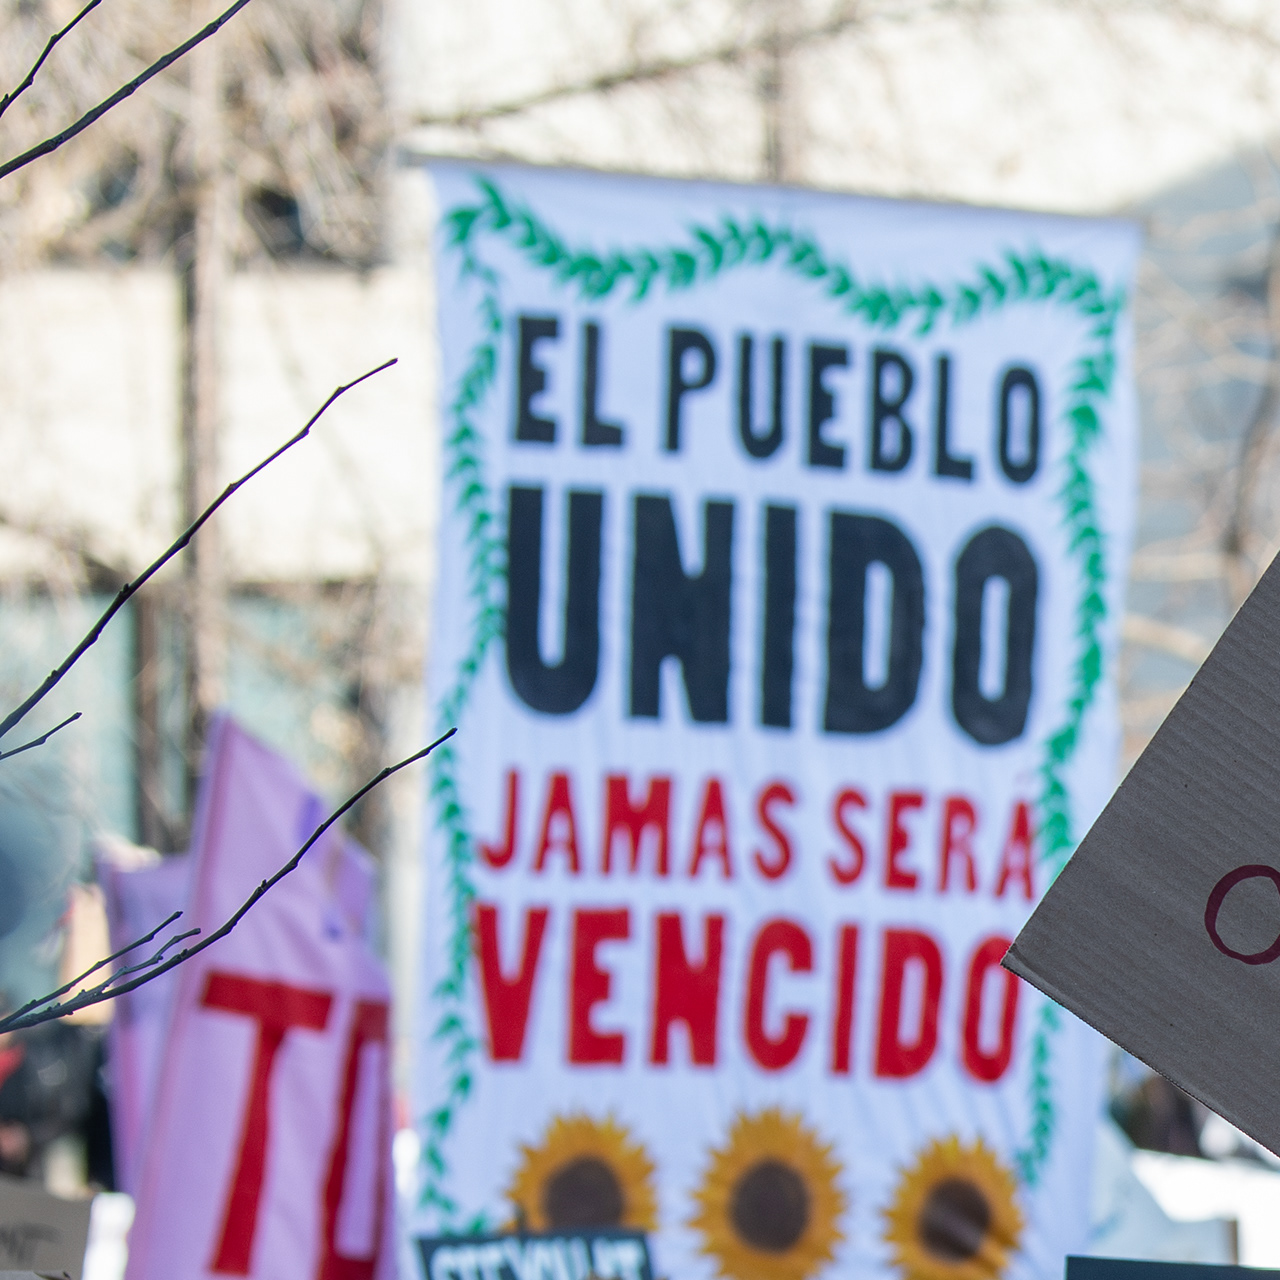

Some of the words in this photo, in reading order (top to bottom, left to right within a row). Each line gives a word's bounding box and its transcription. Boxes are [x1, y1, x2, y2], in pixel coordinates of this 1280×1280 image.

[512, 316, 625, 447] EL
[664, 326, 1041, 485] PUEBLO
[505, 485, 1040, 747] UNIDO
[480, 770, 796, 881] JAMAS
[471, 905, 1022, 1083] VENCIDO
